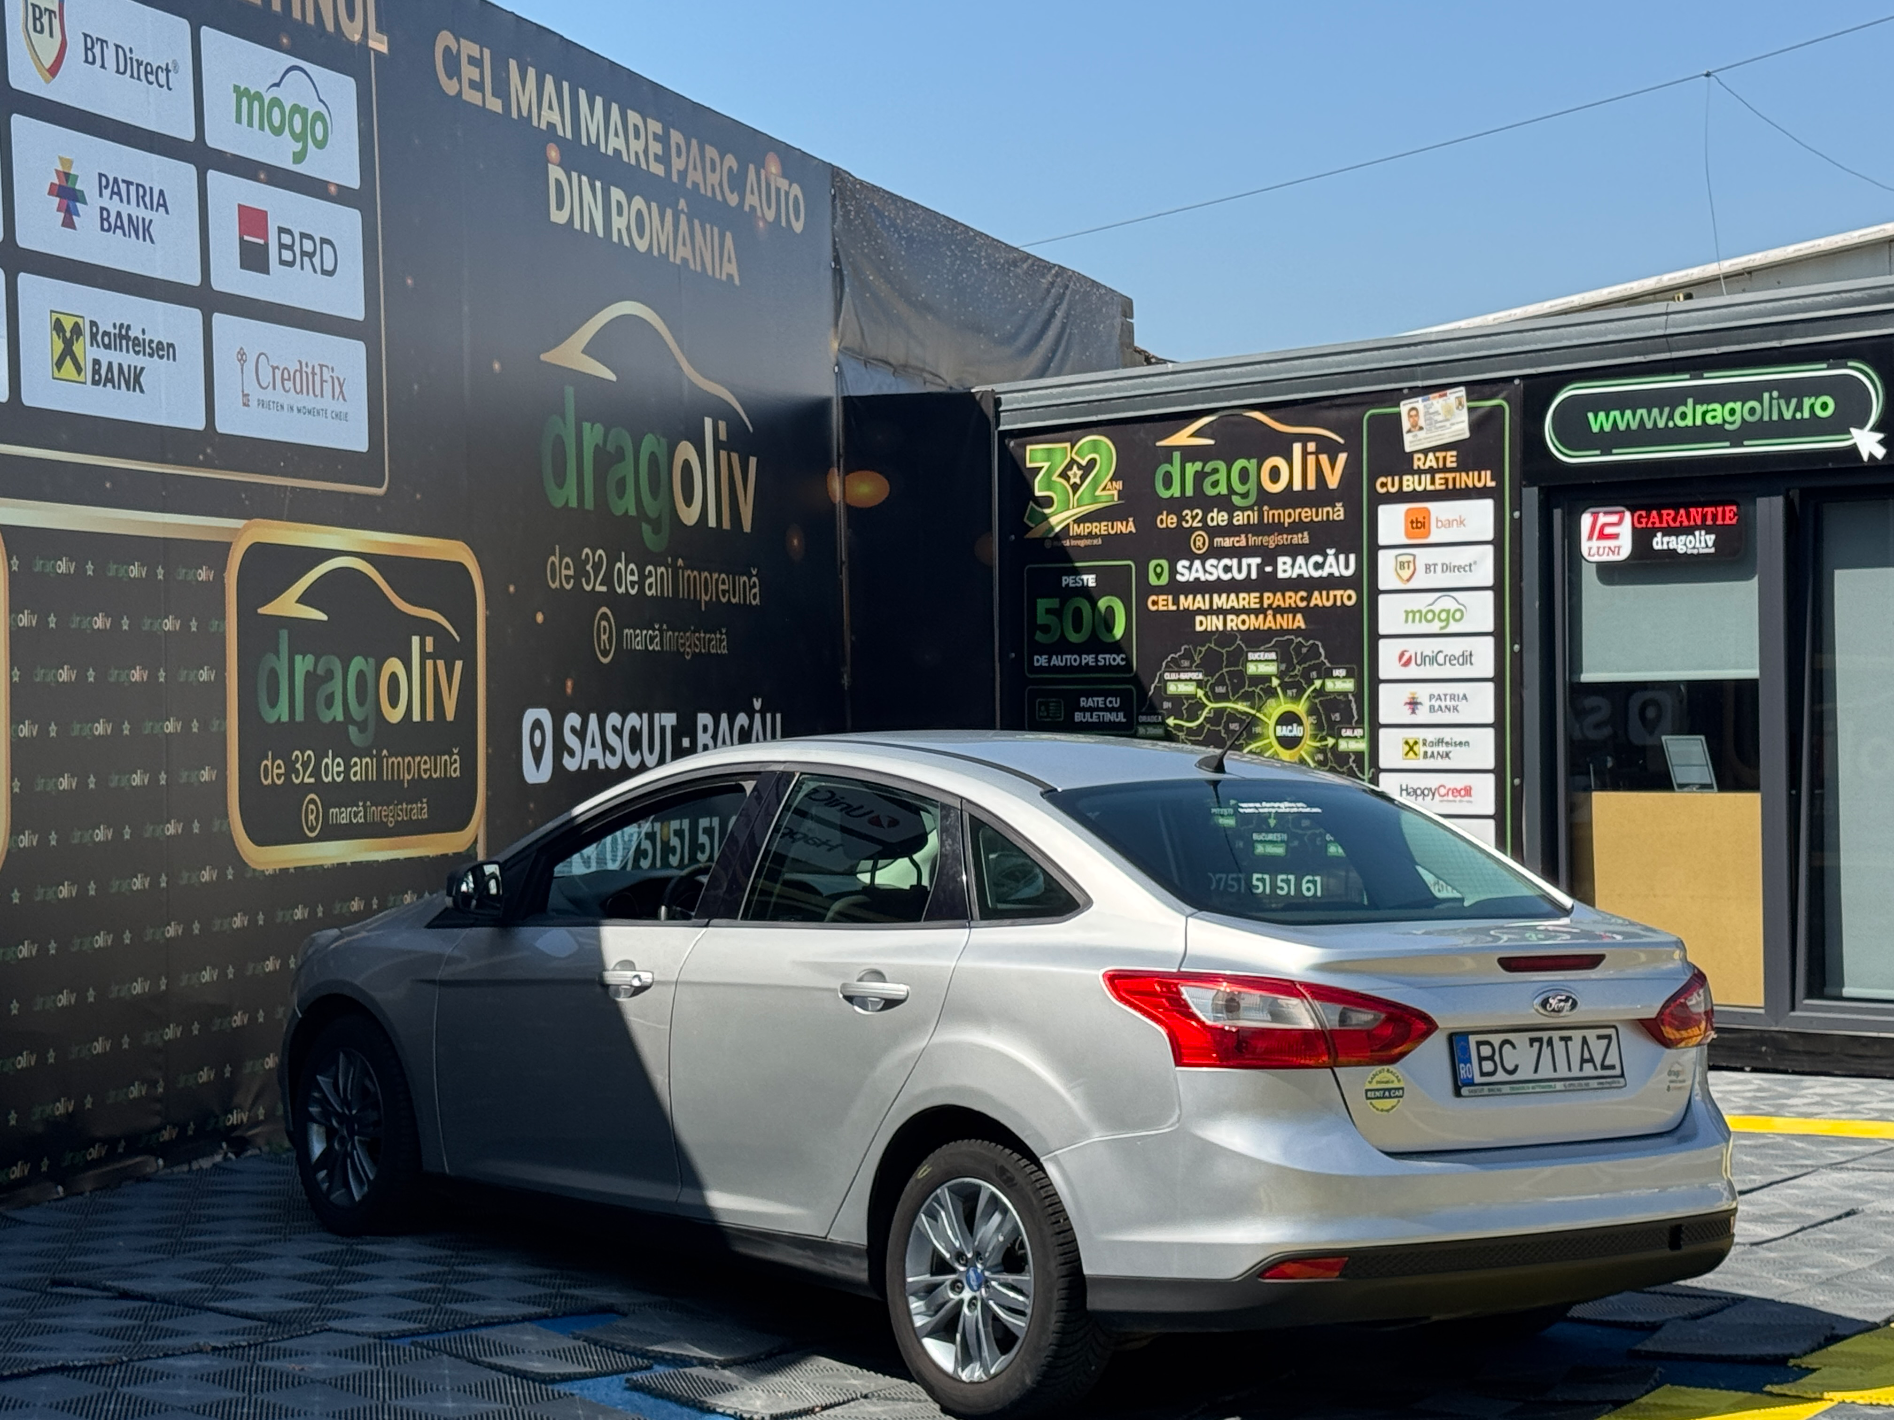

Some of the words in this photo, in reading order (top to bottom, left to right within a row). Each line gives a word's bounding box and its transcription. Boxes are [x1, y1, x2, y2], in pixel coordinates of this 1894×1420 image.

[31, 6, 57, 39] BT
[82, 31, 107, 71] BT
[233, 83, 330, 165] mogo
[434, 30, 503, 114] CEL
[508, 58, 573, 140] MAI
[578, 87, 665, 178] MARE
[670, 128, 740, 208] PARC
[744, 162, 805, 234] AUTO
[98, 172, 170, 216] PATRIA
[99, 206, 156, 245] BANK
[548, 162, 604, 239] DIN
[610, 186, 740, 286] ROMÂNIA
[277, 225, 339, 278] BRD
[89, 319, 177, 363] Raiffeisen
[91, 362, 146, 394] BANK
[254, 352, 348, 403] CreditFix
[257, 398, 285, 412] PRIETEN
[296, 405, 328, 419] MOMENTE
[1587, 390, 1836, 435] www.dragoliv.ro
[540, 384, 758, 552] dragoliv
[1412, 450, 1457, 469] RATE
[1024, 434, 1117, 527] 32
[1106, 480, 1123, 491] ANI
[1154, 441, 1348, 507] dragoliv
[1375, 476, 1400, 494] CU
[1402, 470, 1496, 492] BULETINUL
[1069, 517, 1137, 537] ÎMPREUNĂ
[1156, 510, 1177, 529] de
[1181, 509, 1203, 528] 32
[1207, 508, 1229, 527] de
[1233, 506, 1259, 526] ani
[1263, 502, 1345, 527] împreună
[1409, 516, 1426, 530] tbi
[1435, 515, 1466, 529] bank
[1587, 512, 1625, 541] 12
[1633, 505, 1739, 529] GARANTIE
[1213, 533, 1247, 548] marcă
[1248, 531, 1310, 549] înregistrată
[1587, 545, 1621, 558] LUNI
[1652, 530, 1716, 554] dragoliv
[1175, 557, 1262, 582] SASCUT
[1276, 548, 1356, 579] BACĂU
[1399, 560, 1411, 571] BT
[1424, 563, 1438, 575] BT
[546, 545, 575, 590] de
[581, 546, 608, 592] 32
[613, 551, 639, 596] de
[644, 556, 673, 598] ani
[677, 557, 761, 612] împreună
[1061, 574, 1097, 588] PESTE
[1147, 593, 1177, 611] CEL
[1179, 593, 1210, 611] MAI
[1212, 592, 1261, 610] MARE
[1262, 590, 1308, 609] PARC
[1309, 589, 1358, 608] AUTO
[1034, 595, 1126, 644] 500
[1194, 614, 1224, 632] DIN
[1228, 610, 1306, 631] ROMÂNIA
[1404, 606, 1464, 631] mogo
[623, 622, 662, 651] marcă
[662, 623, 729, 660] înregistrată
[1033, 654, 1049, 667] DE
[1050, 654, 1080, 666] AUTO
[1081, 654, 1096, 666] PE
[1097, 653, 1127, 666] STOC
[1414, 650, 1474, 667] UniCredit
[257, 628, 464, 748] dragoliv
[1428, 692, 1468, 703] PATRIA
[1079, 697, 1105, 708] RATE
[1107, 697, 1121, 708] CU
[1428, 704, 1460, 714] BANK
[1074, 711, 1127, 723] BULETINUL
[562, 711, 677, 772] SASCUT
[1421, 738, 1470, 749] Raiffeisen
[260, 751, 285, 786] de
[291, 749, 316, 784] 32
[321, 748, 345, 783] de
[350, 750, 377, 782] ani
[382, 747, 461, 788] împreună
[1421, 750, 1452, 761] BANK
[1400, 783, 1473, 802] HappyCredit
[329, 801, 365, 825] marcă
[367, 798, 429, 827] înregistrată
[669, 818, 690, 867] 51
[697, 816, 719, 864] 51
[1252, 873, 1270, 895] 51
[1276, 874, 1295, 896] 51
[1302, 875, 1322, 898] 61
[1546, 995, 1572, 1012] Ford
[1459, 1062, 1474, 1080] RO
[1475, 1039, 1520, 1078] BC
